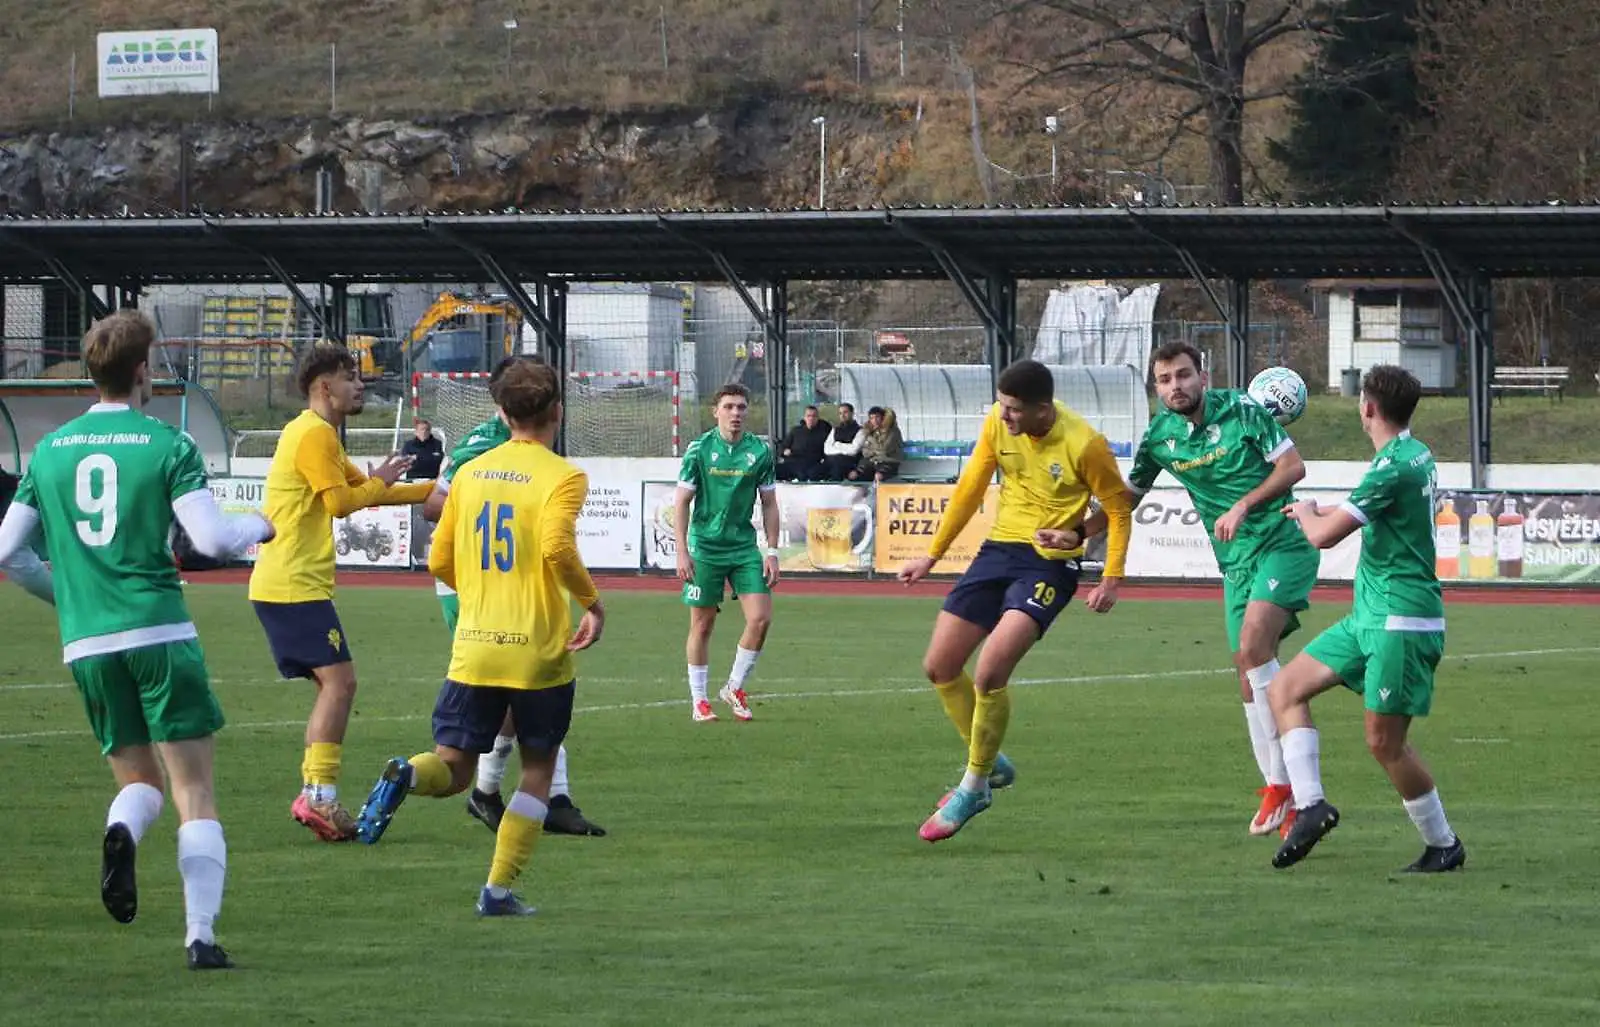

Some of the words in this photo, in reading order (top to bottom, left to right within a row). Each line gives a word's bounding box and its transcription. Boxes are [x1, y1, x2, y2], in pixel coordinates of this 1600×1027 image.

[1268, 384, 1296, 409] SELECT
[484, 470, 532, 484] BENEŠOV
[75, 453, 118, 546] 9
[235, 483, 265, 501] AUT
[1135, 502, 1200, 526] Cro
[475, 500, 515, 573] 15
[687, 584, 701, 601] 20
[1033, 580, 1057, 606] 19
